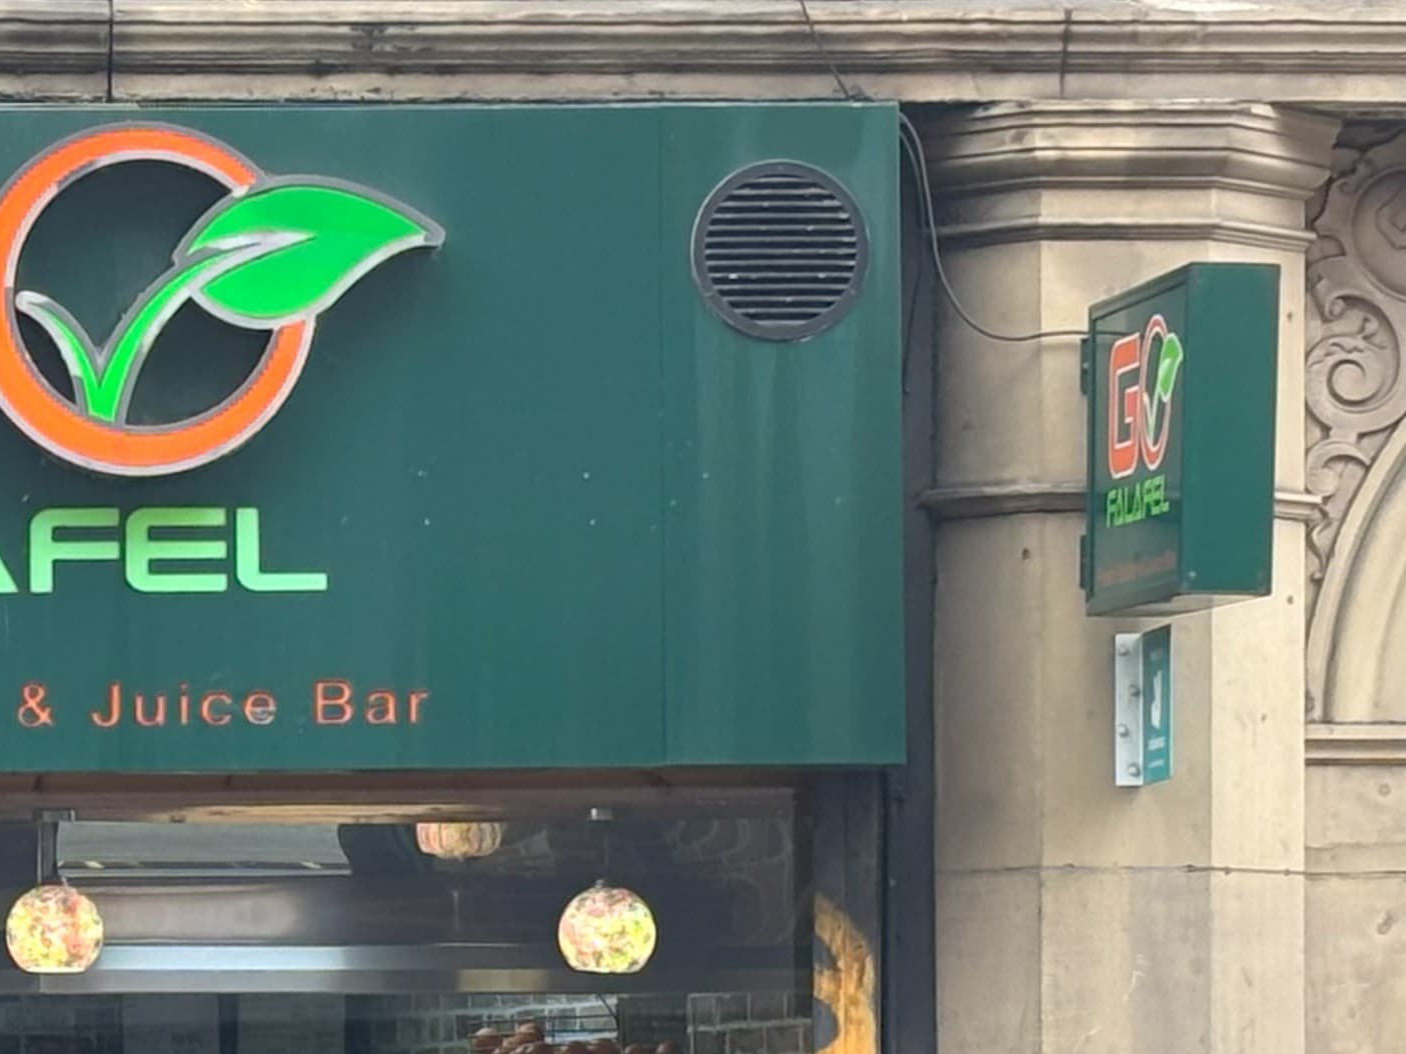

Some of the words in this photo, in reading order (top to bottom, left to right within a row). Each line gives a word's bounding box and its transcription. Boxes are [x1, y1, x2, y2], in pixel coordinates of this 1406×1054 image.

[1109, 313, 1184, 479] GO
[1105, 474, 1171, 529] FALAFEL
[17, 681, 55, 727] &
[91, 681, 278, 728] Juice
[313, 679, 430, 726] Bar
